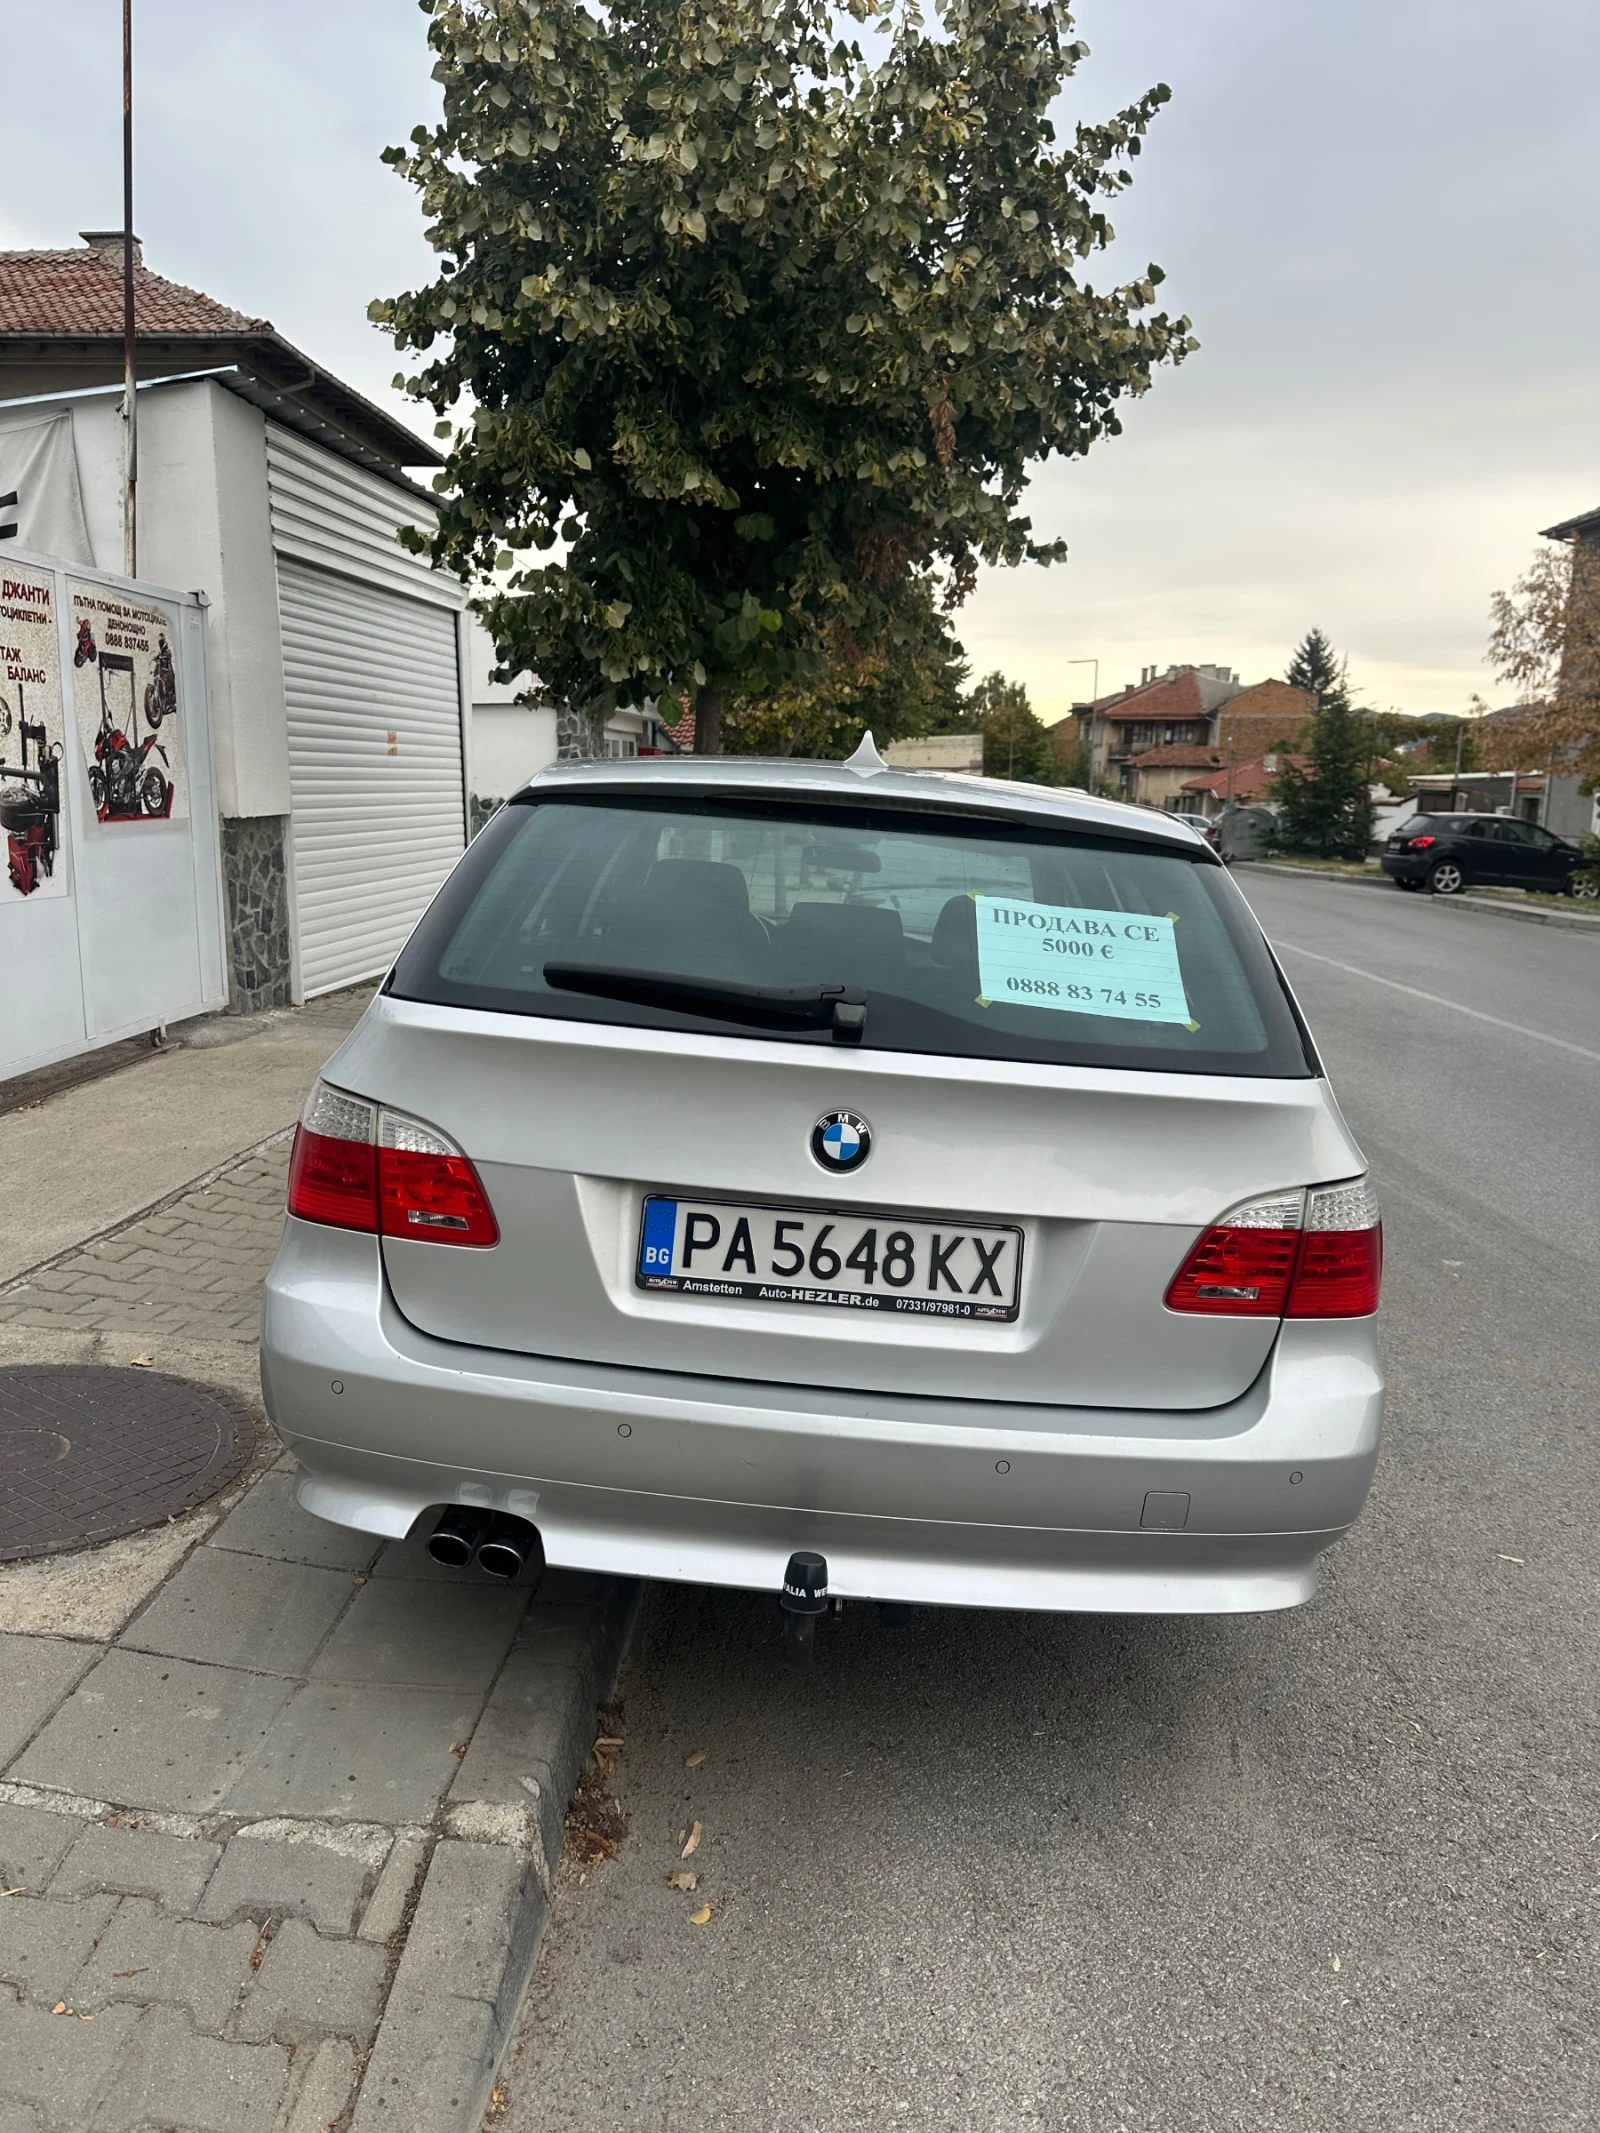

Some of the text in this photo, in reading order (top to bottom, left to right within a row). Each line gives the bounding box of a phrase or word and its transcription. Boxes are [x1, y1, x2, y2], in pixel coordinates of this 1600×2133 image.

[2, 579, 49, 605] ДЖАНТИ
[0, 604, 47, 625] ОЦИКЛЕТНИ
[97, 600, 122, 619] ПОМОЩ
[105, 632, 149, 652] 0888 837455
[7, 665, 46, 684] БАЛАНС
[992, 907, 1160, 943] ПРОДАВА СЕ
[1042, 938, 1115, 959] 5000 €
[1006, 976, 1161, 1009] 0888 83 74 55
[818, 1113, 868, 1134] BMW
[645, 1246, 669, 1265] BG
[682, 1280, 970, 1316] Amstetten Auto-HEZLER.de 07331/97981-0
